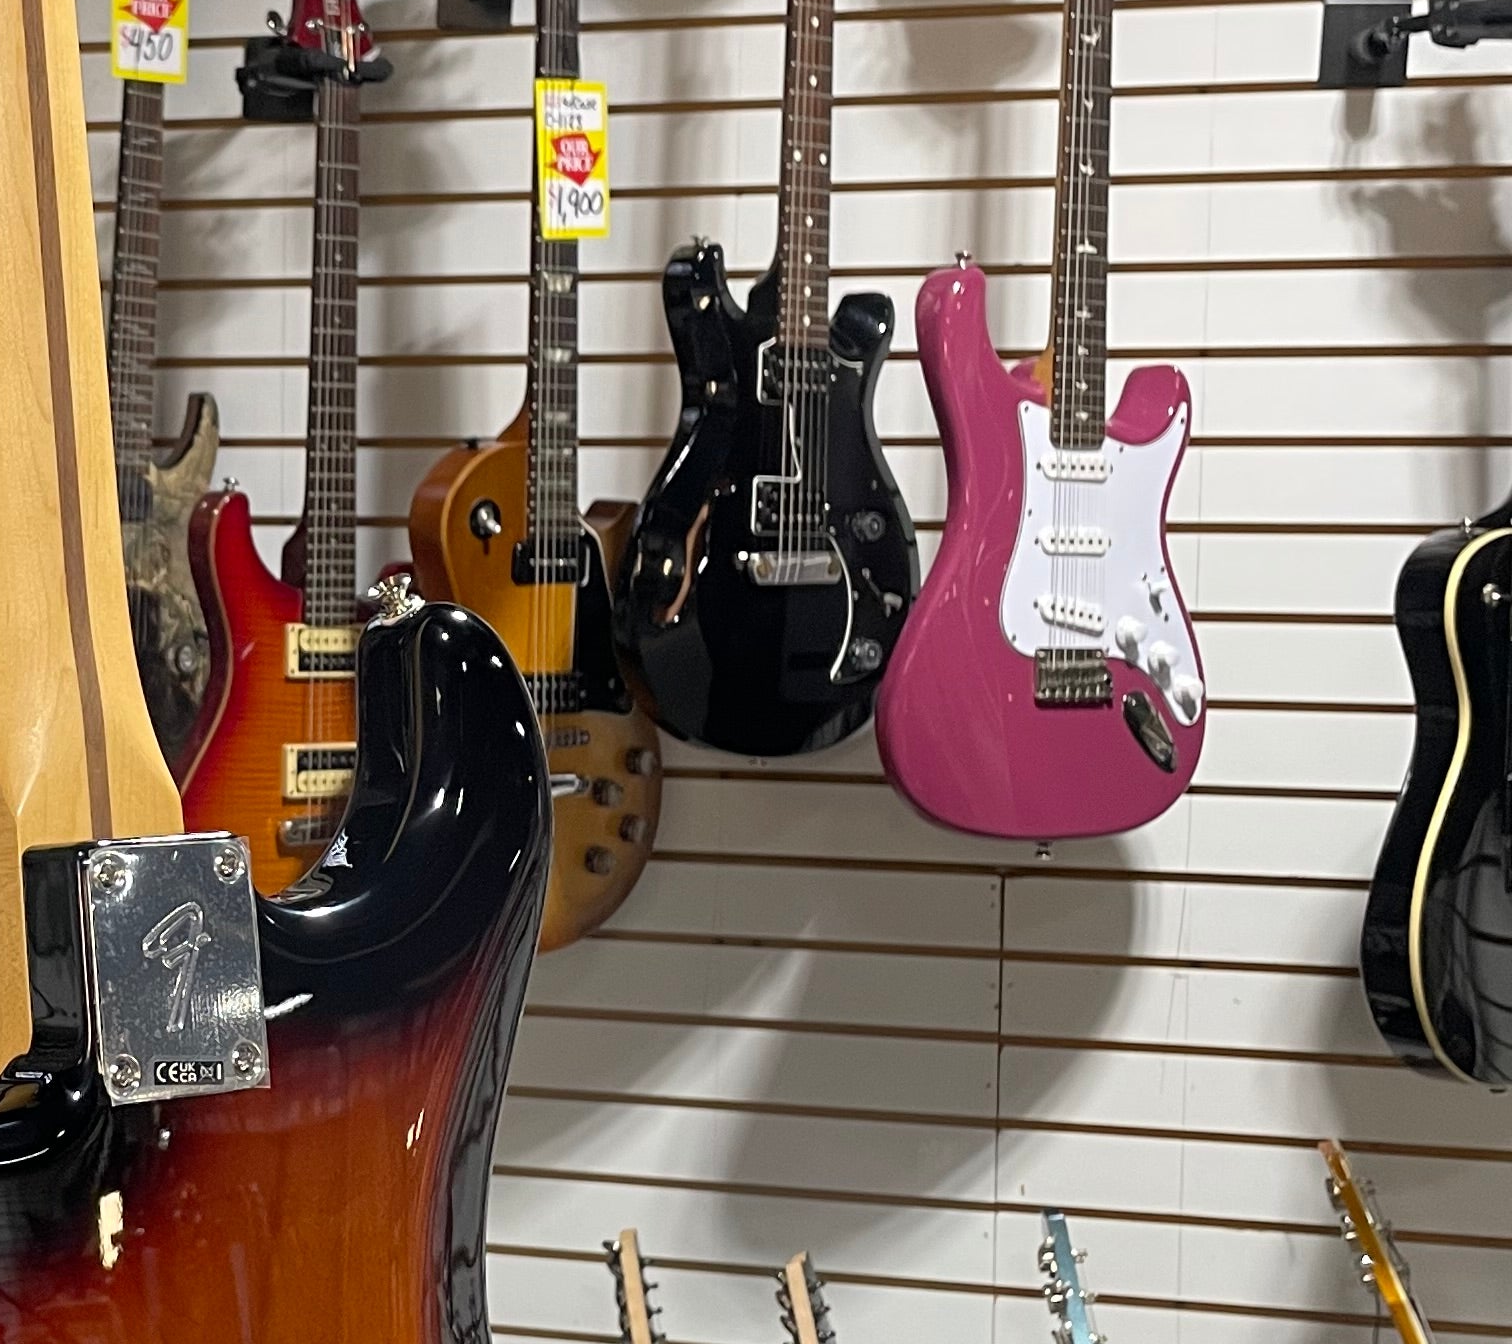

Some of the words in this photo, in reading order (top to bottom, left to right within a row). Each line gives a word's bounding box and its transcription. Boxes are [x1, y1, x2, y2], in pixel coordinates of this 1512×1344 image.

[132, 0, 174, 18] PRICE
[559, 137, 589, 155] OUR
[557, 155, 594, 173] PRICE
[179, 1062, 196, 1072] UK
[179, 1072, 198, 1084] CA
